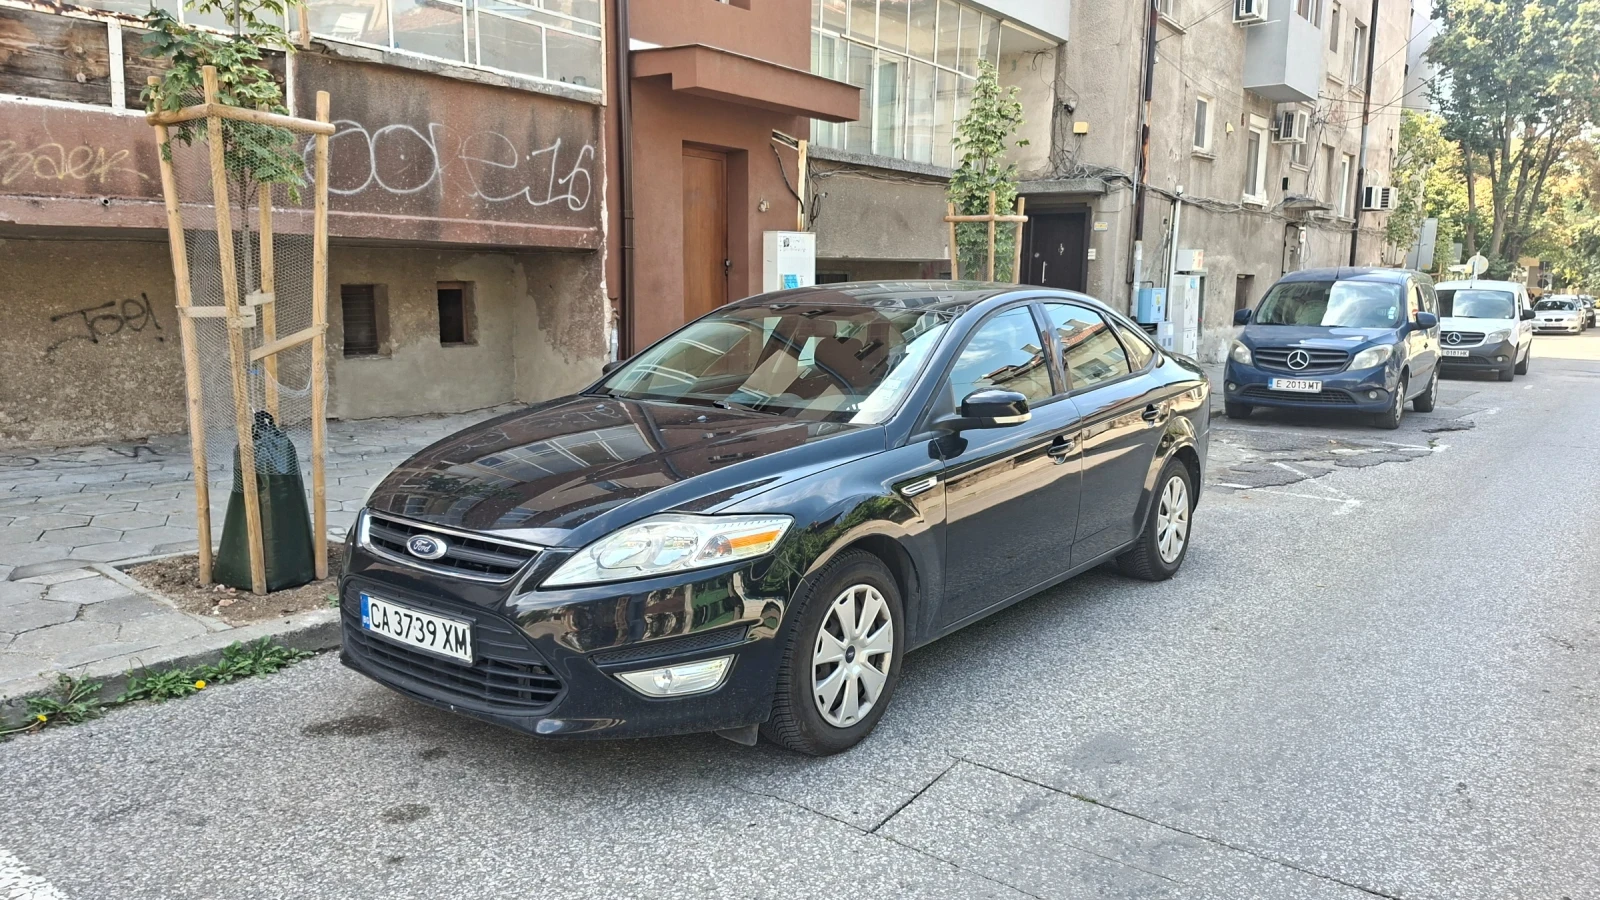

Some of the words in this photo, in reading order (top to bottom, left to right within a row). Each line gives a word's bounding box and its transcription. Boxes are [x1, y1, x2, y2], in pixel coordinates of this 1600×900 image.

[1276, 379, 1282, 388] E
[1285, 380, 1307, 389] 2013
[413, 539, 432, 553] Ford
[370, 602, 391, 634] CA
[394, 610, 437, 647] 3739
[442, 622, 468, 656] XM
